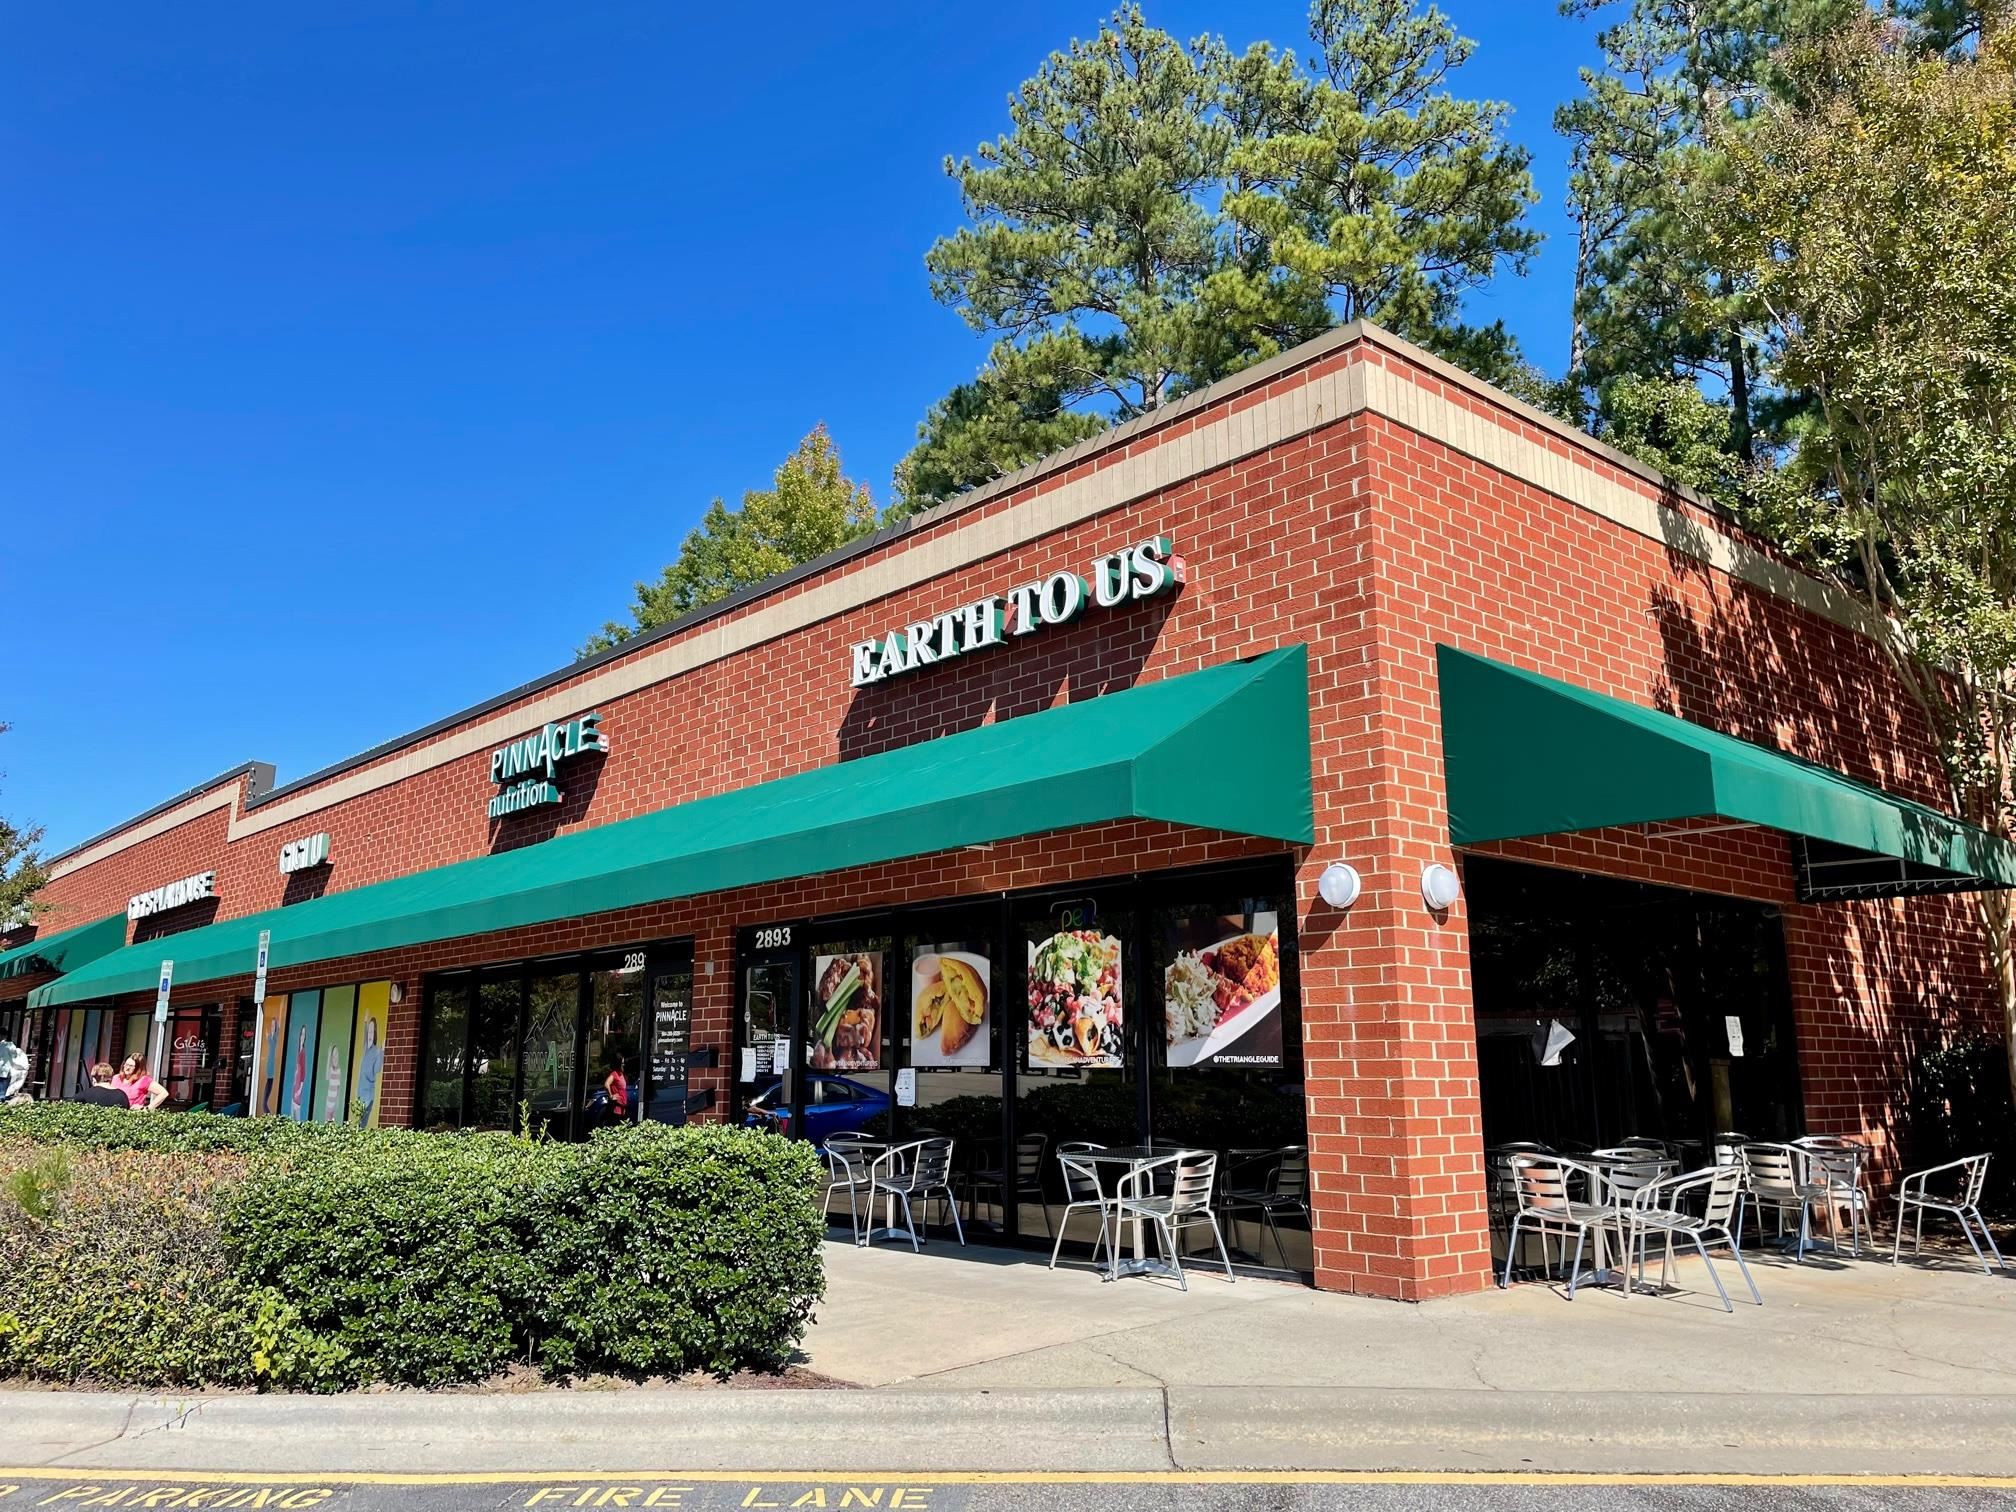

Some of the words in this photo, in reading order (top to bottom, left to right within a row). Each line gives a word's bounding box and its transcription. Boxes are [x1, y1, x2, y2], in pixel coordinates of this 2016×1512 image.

[850, 595, 1008, 688] EARTH
[1008, 571, 1085, 636] TO
[1091, 535, 1172, 607] US
[490, 713, 602, 783] PINNACLE
[488, 779, 555, 818] nutrition
[310, 832, 327, 865] U
[755, 927, 792, 949] 2893
[624, 951, 646, 971] 289
[655, 1009, 687, 1028] PINNACLE
[1213, 1055, 1280, 1064] @THETRIANGLEGUIDE
[36, 1485, 334, 1510] PARKING
[522, 1486, 695, 1507] FIRE
[739, 1486, 934, 1508] LANE
